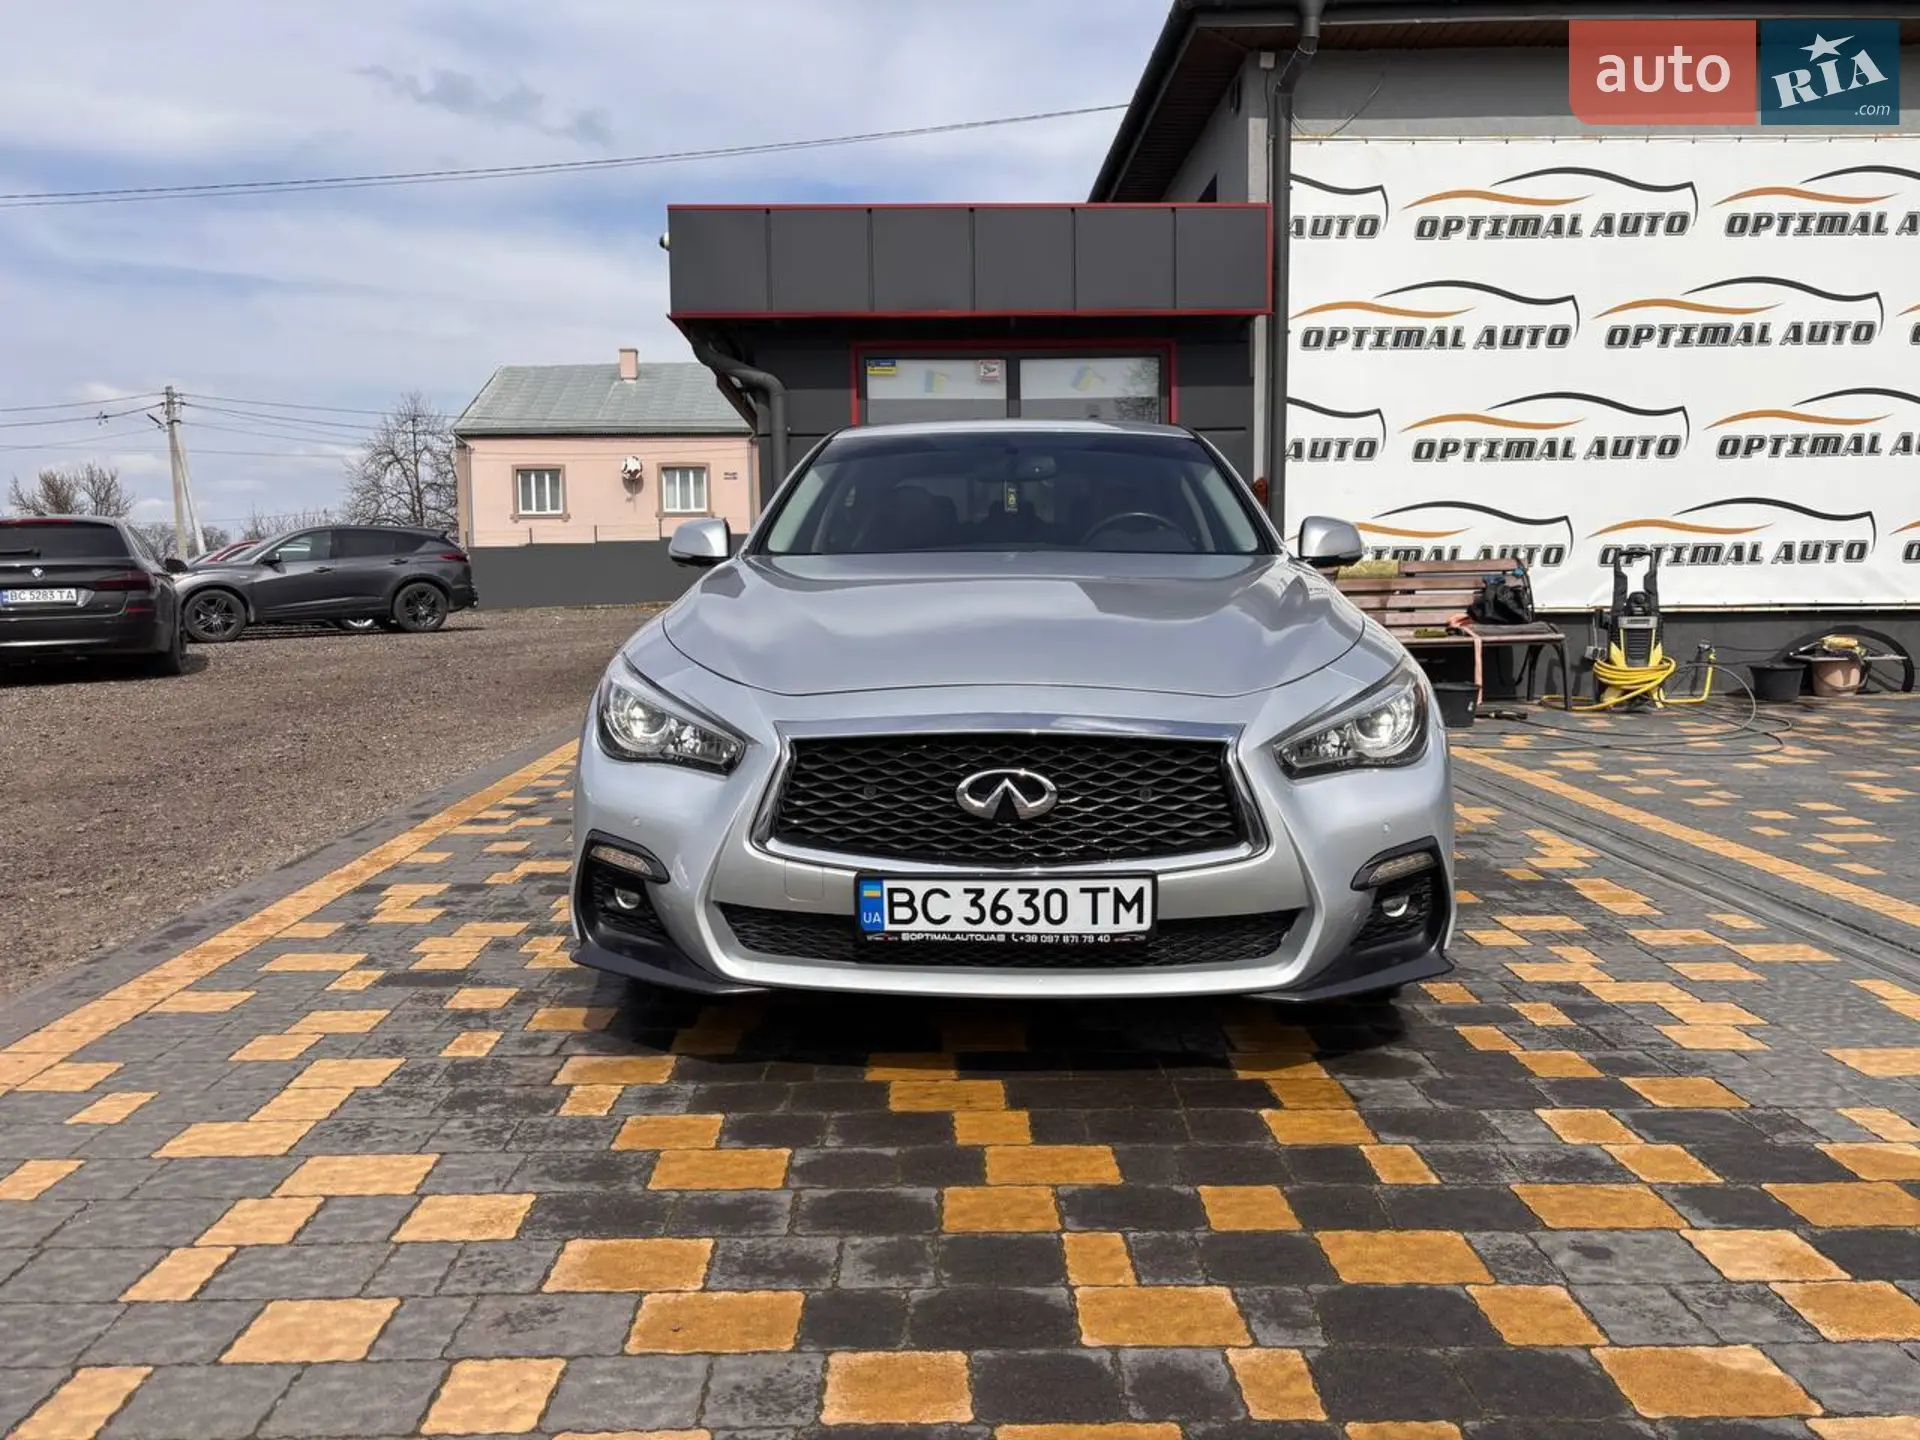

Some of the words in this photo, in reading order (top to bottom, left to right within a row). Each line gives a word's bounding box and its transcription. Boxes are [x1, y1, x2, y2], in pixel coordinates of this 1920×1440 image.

[1289, 214, 1381, 239] AUTO
[1414, 213, 1583, 240] OPTIMAL
[1590, 211, 1691, 238] AUTO
[1724, 211, 1888, 237] OPTIMAL
[1300, 325, 1465, 350] OPTIMAL
[1473, 324, 1572, 349] AUTO
[1605, 322, 1772, 348] OPTIMAL
[1779, 320, 1877, 346] AUTO
[1286, 437, 1378, 462] AUTO
[1411, 437, 1576, 462] OPTIMAL
[1583, 435, 1682, 461] AUTO
[1716, 433, 1882, 459] OPTIMAL
[1598, 541, 1763, 567] OPTIMAL
[1771, 540, 1870, 564] AUTO
[10, 590, 26, 601] BC
[57, 590, 74, 600] TA
[863, 912, 882, 924] UA
[887, 887, 951, 925] BC
[963, 887, 1069, 925] 3630
[1079, 886, 1144, 925] TM
